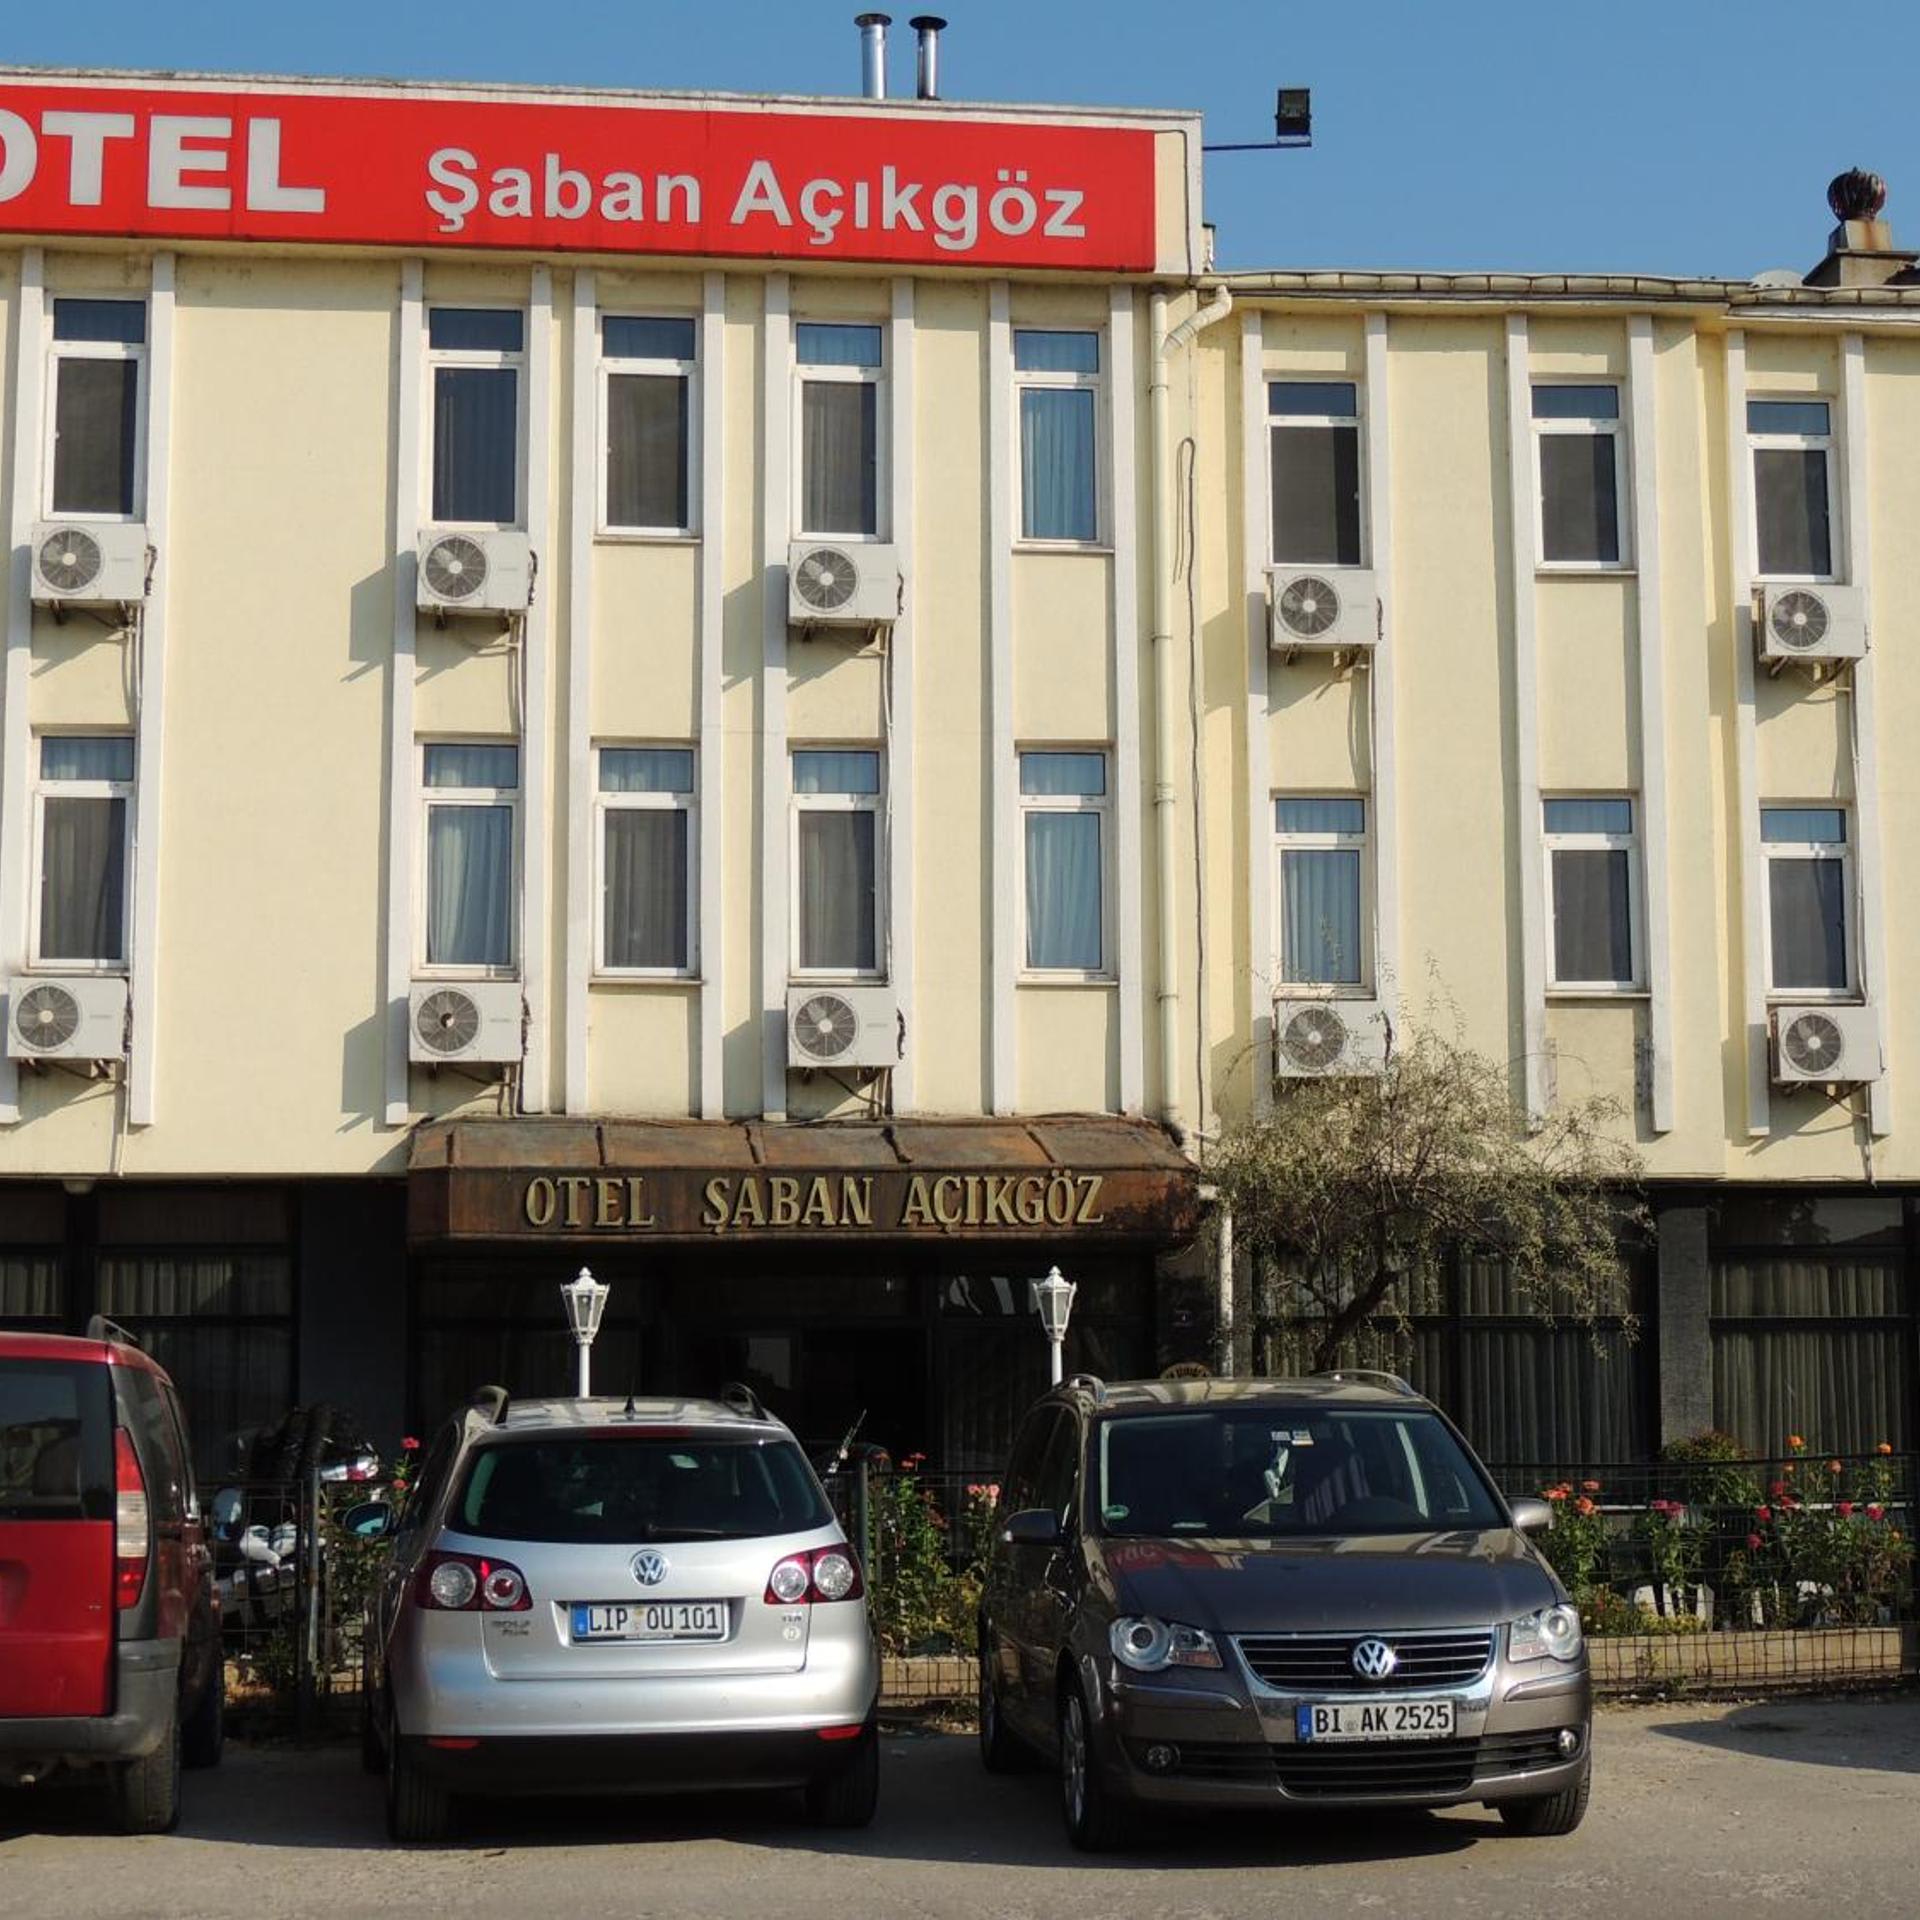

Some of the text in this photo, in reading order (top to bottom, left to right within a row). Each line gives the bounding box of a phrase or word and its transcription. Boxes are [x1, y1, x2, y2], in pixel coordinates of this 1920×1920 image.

[424, 147, 701, 234] Şaban
[729, 159, 1087, 252] Açıkgöz
[524, 1168, 1105, 1234] OTEL ŞABAN AÇIKGÖZ
[589, 1605, 718, 1632] LIP OU 101
[1354, 1640, 1393, 1679] VW
[1315, 1703, 1449, 1734] BI AK 2525
